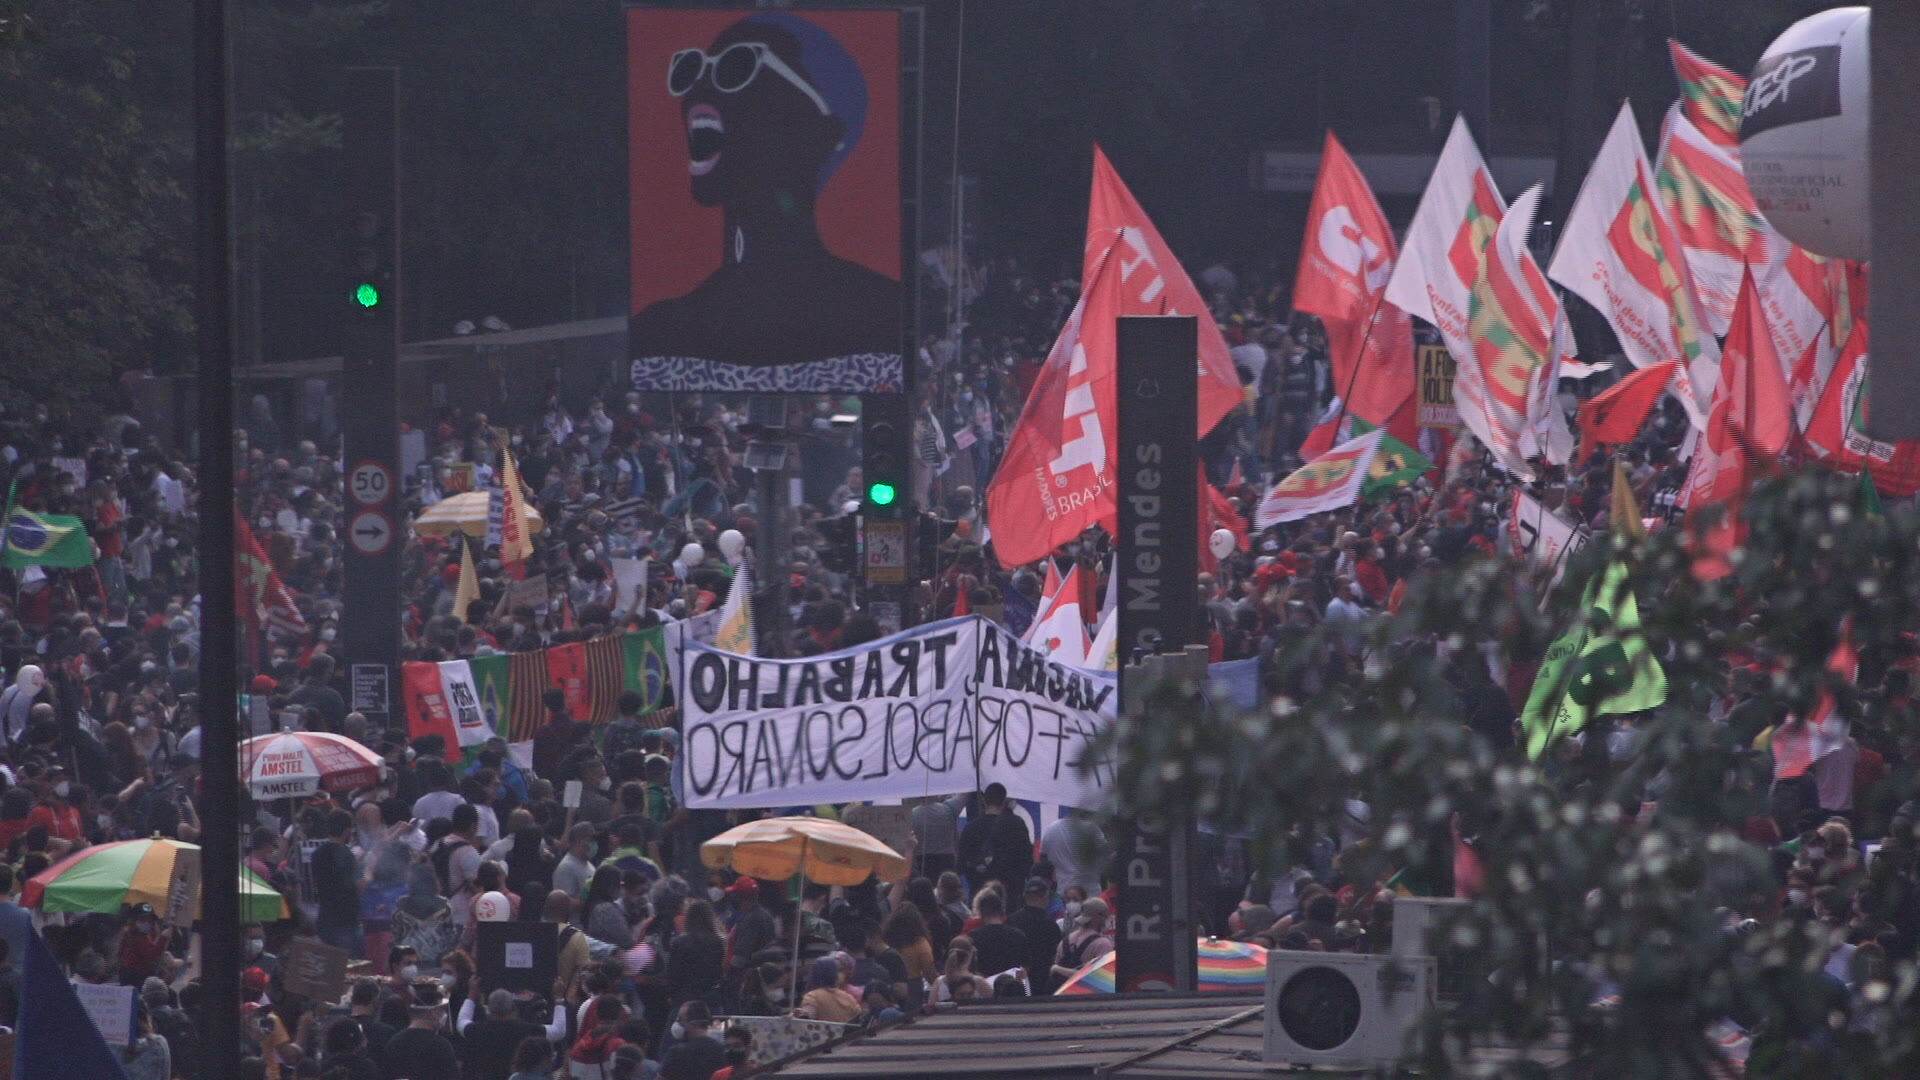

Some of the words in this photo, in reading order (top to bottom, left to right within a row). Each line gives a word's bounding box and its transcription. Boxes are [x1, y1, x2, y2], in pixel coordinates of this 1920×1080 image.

[356, 471, 385, 491] 50
[1127, 442, 1162, 611] Mendes
[260, 760, 304, 777] AMSTEL
[262, 782, 307, 795] AMSTEL
[1126, 904, 1161, 940] R.
